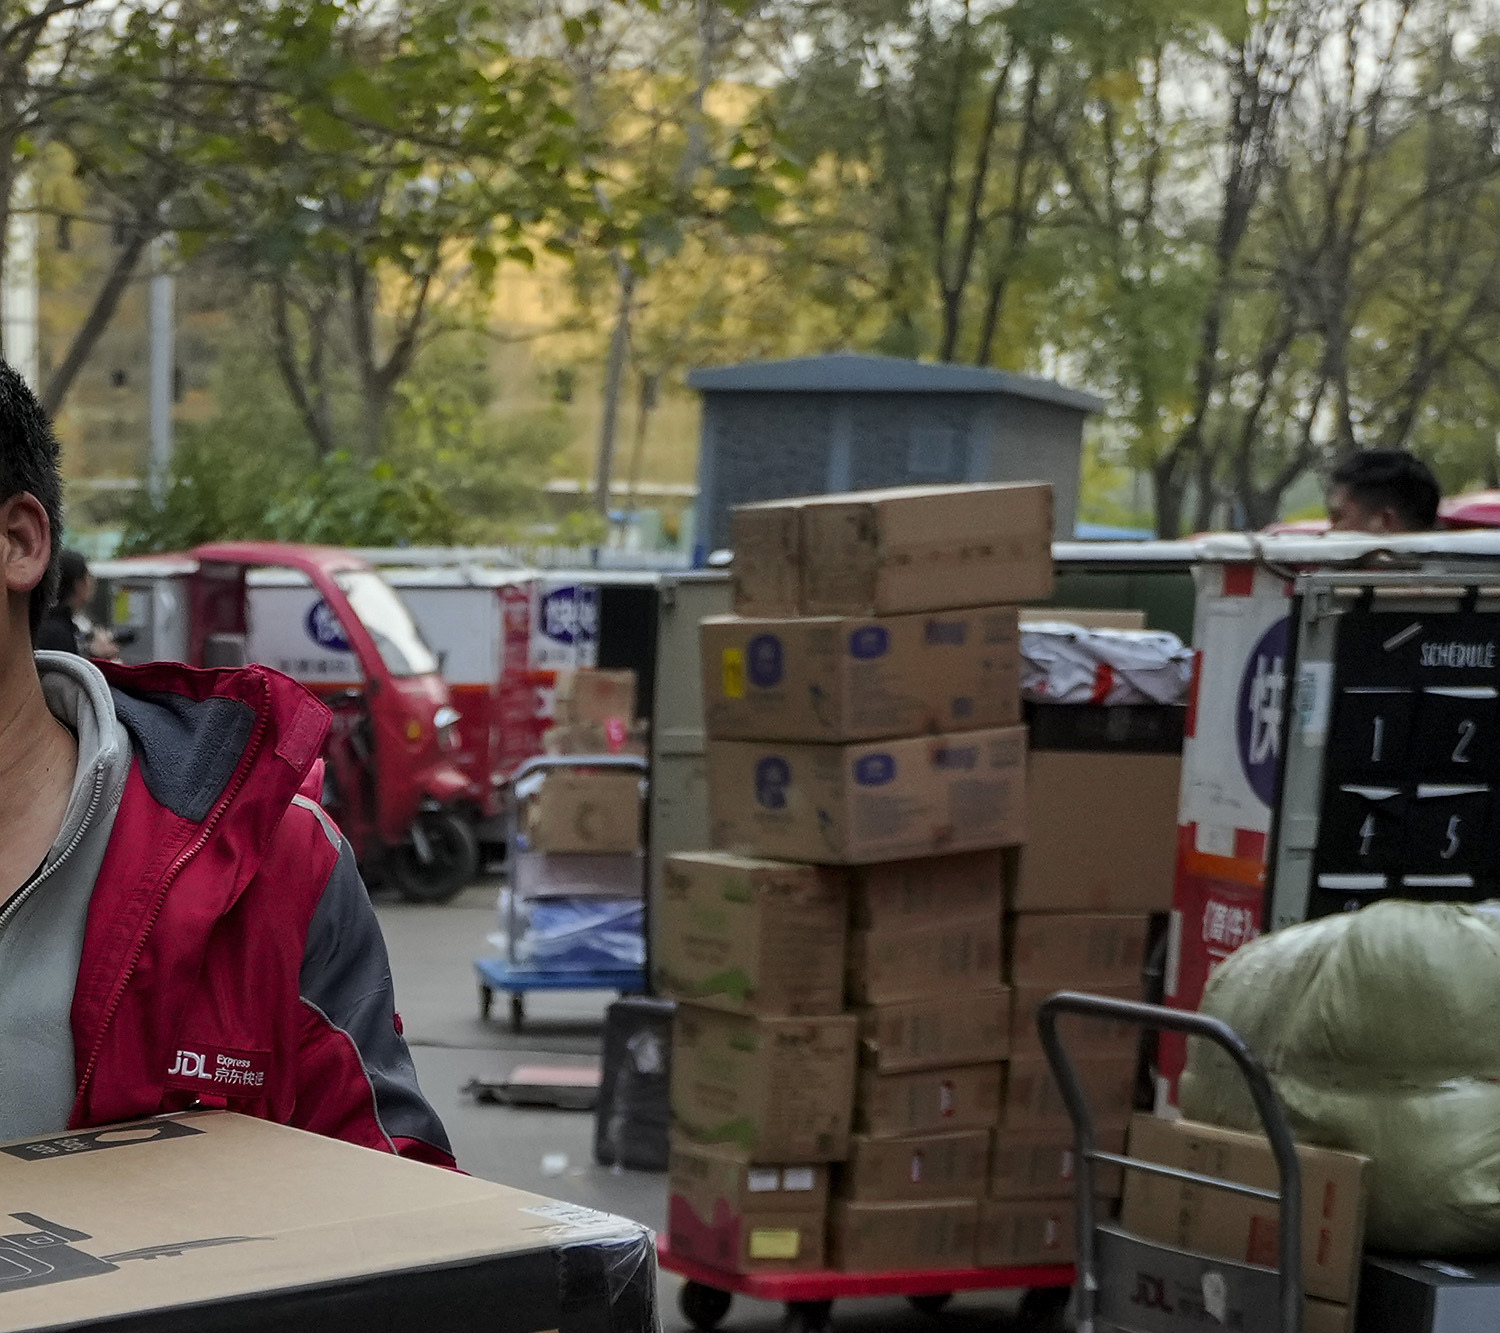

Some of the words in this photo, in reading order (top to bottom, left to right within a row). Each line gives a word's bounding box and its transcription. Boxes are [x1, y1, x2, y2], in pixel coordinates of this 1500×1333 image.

[1369, 714, 1385, 764] 1
[1450, 718, 1477, 765] 2
[168, 1050, 213, 1080] JDL
[216, 1053, 251, 1069] Express
